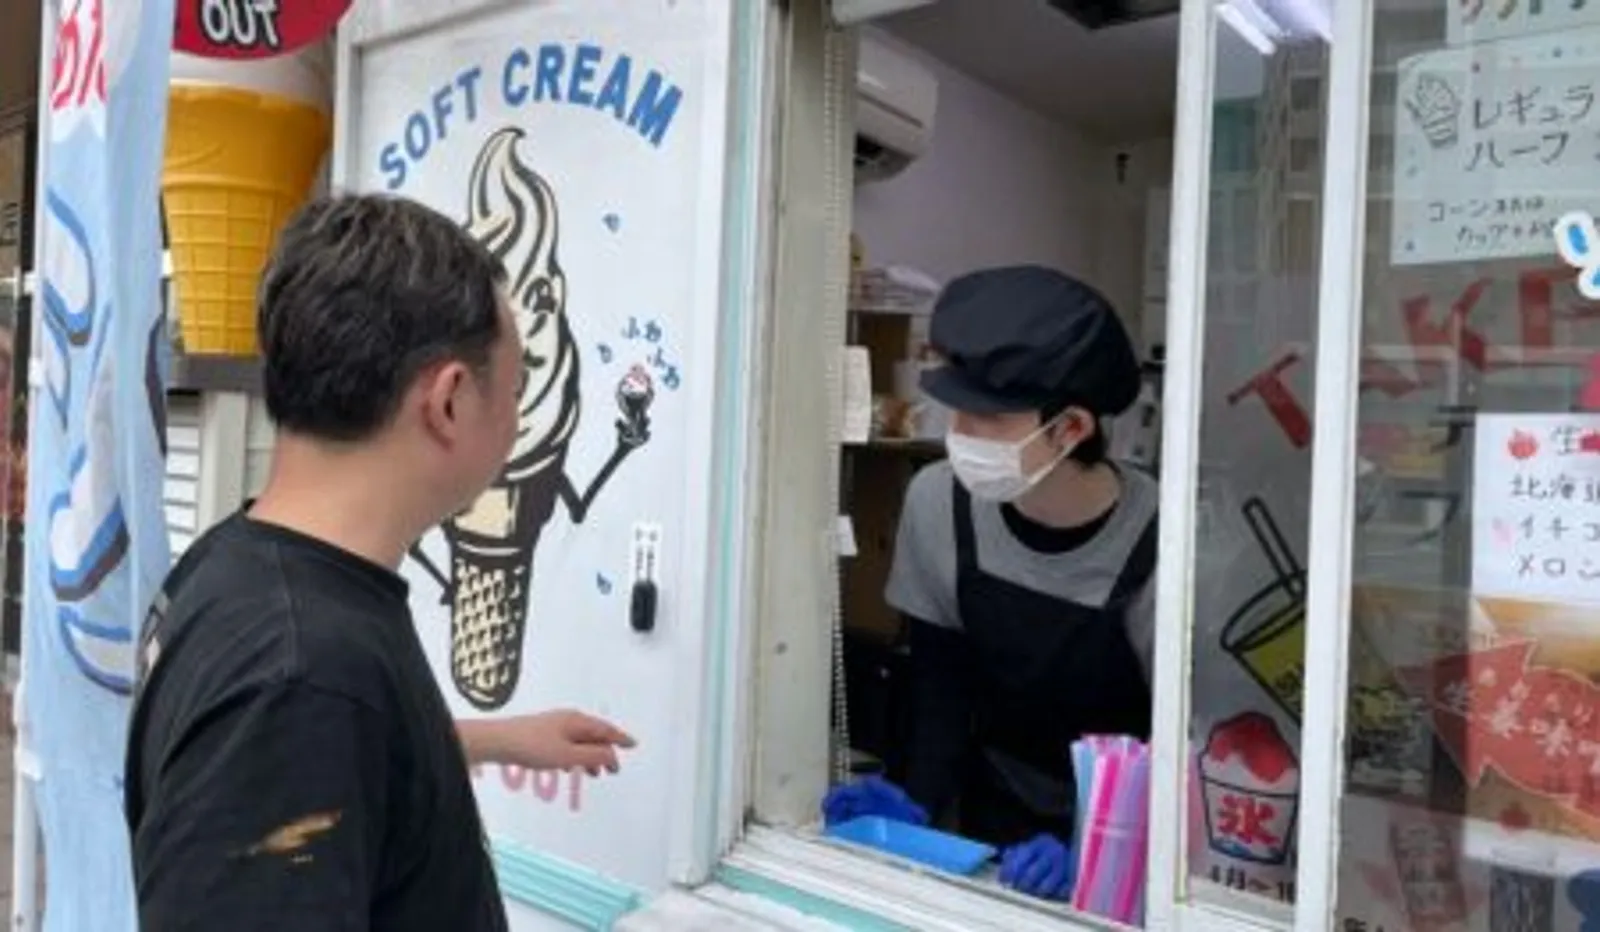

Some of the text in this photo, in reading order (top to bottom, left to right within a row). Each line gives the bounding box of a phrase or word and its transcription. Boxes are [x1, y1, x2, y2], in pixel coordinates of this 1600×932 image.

[204, 0, 279, 47] OUT
[379, 43, 684, 190] SOFT CREAM
[1464, 131, 1570, 172] ハーフ
[1215, 793, 1279, 844] 氷
